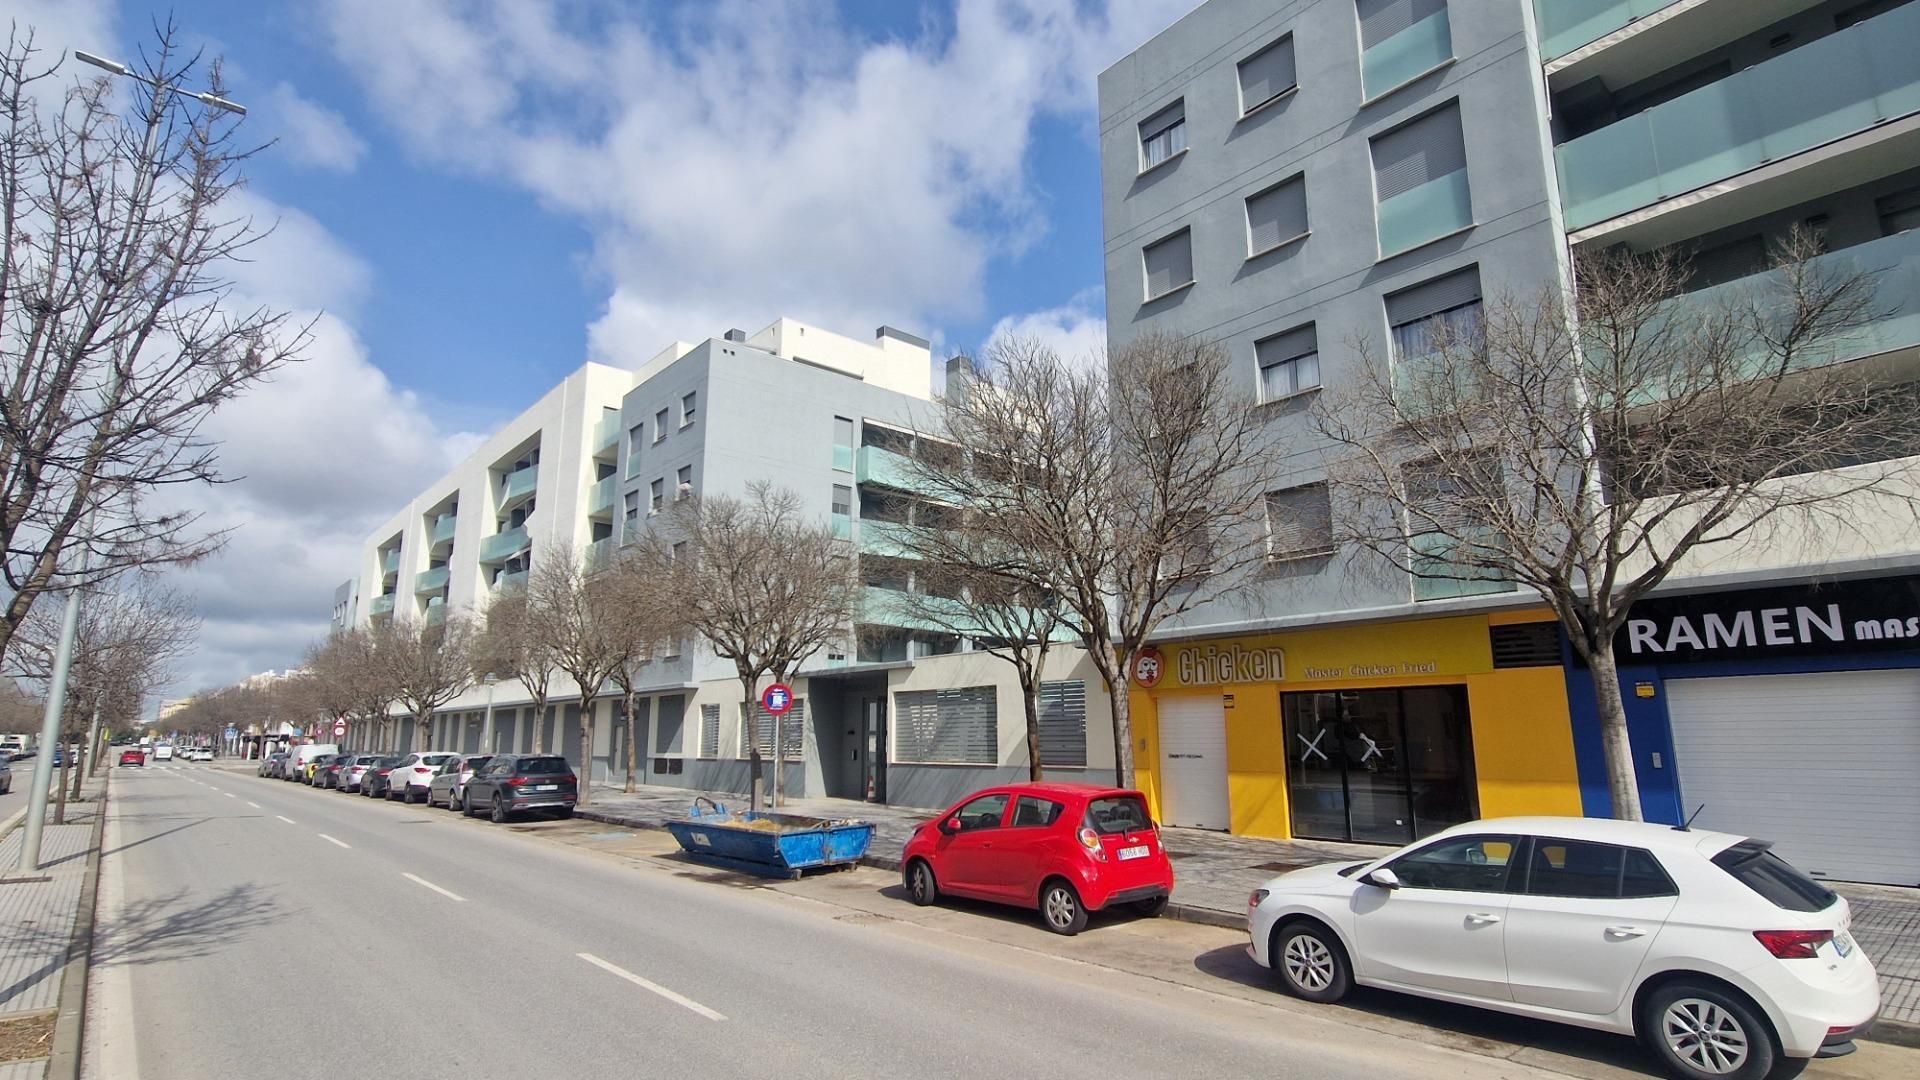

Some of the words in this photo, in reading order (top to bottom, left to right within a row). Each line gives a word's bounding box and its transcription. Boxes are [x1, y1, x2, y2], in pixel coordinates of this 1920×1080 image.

[1627, 603, 1844, 653] RAMEN
[1178, 645, 1285, 685] Chicken
[1348, 664, 1396, 676] Chicken
[1402, 661, 1436, 673] Fried
